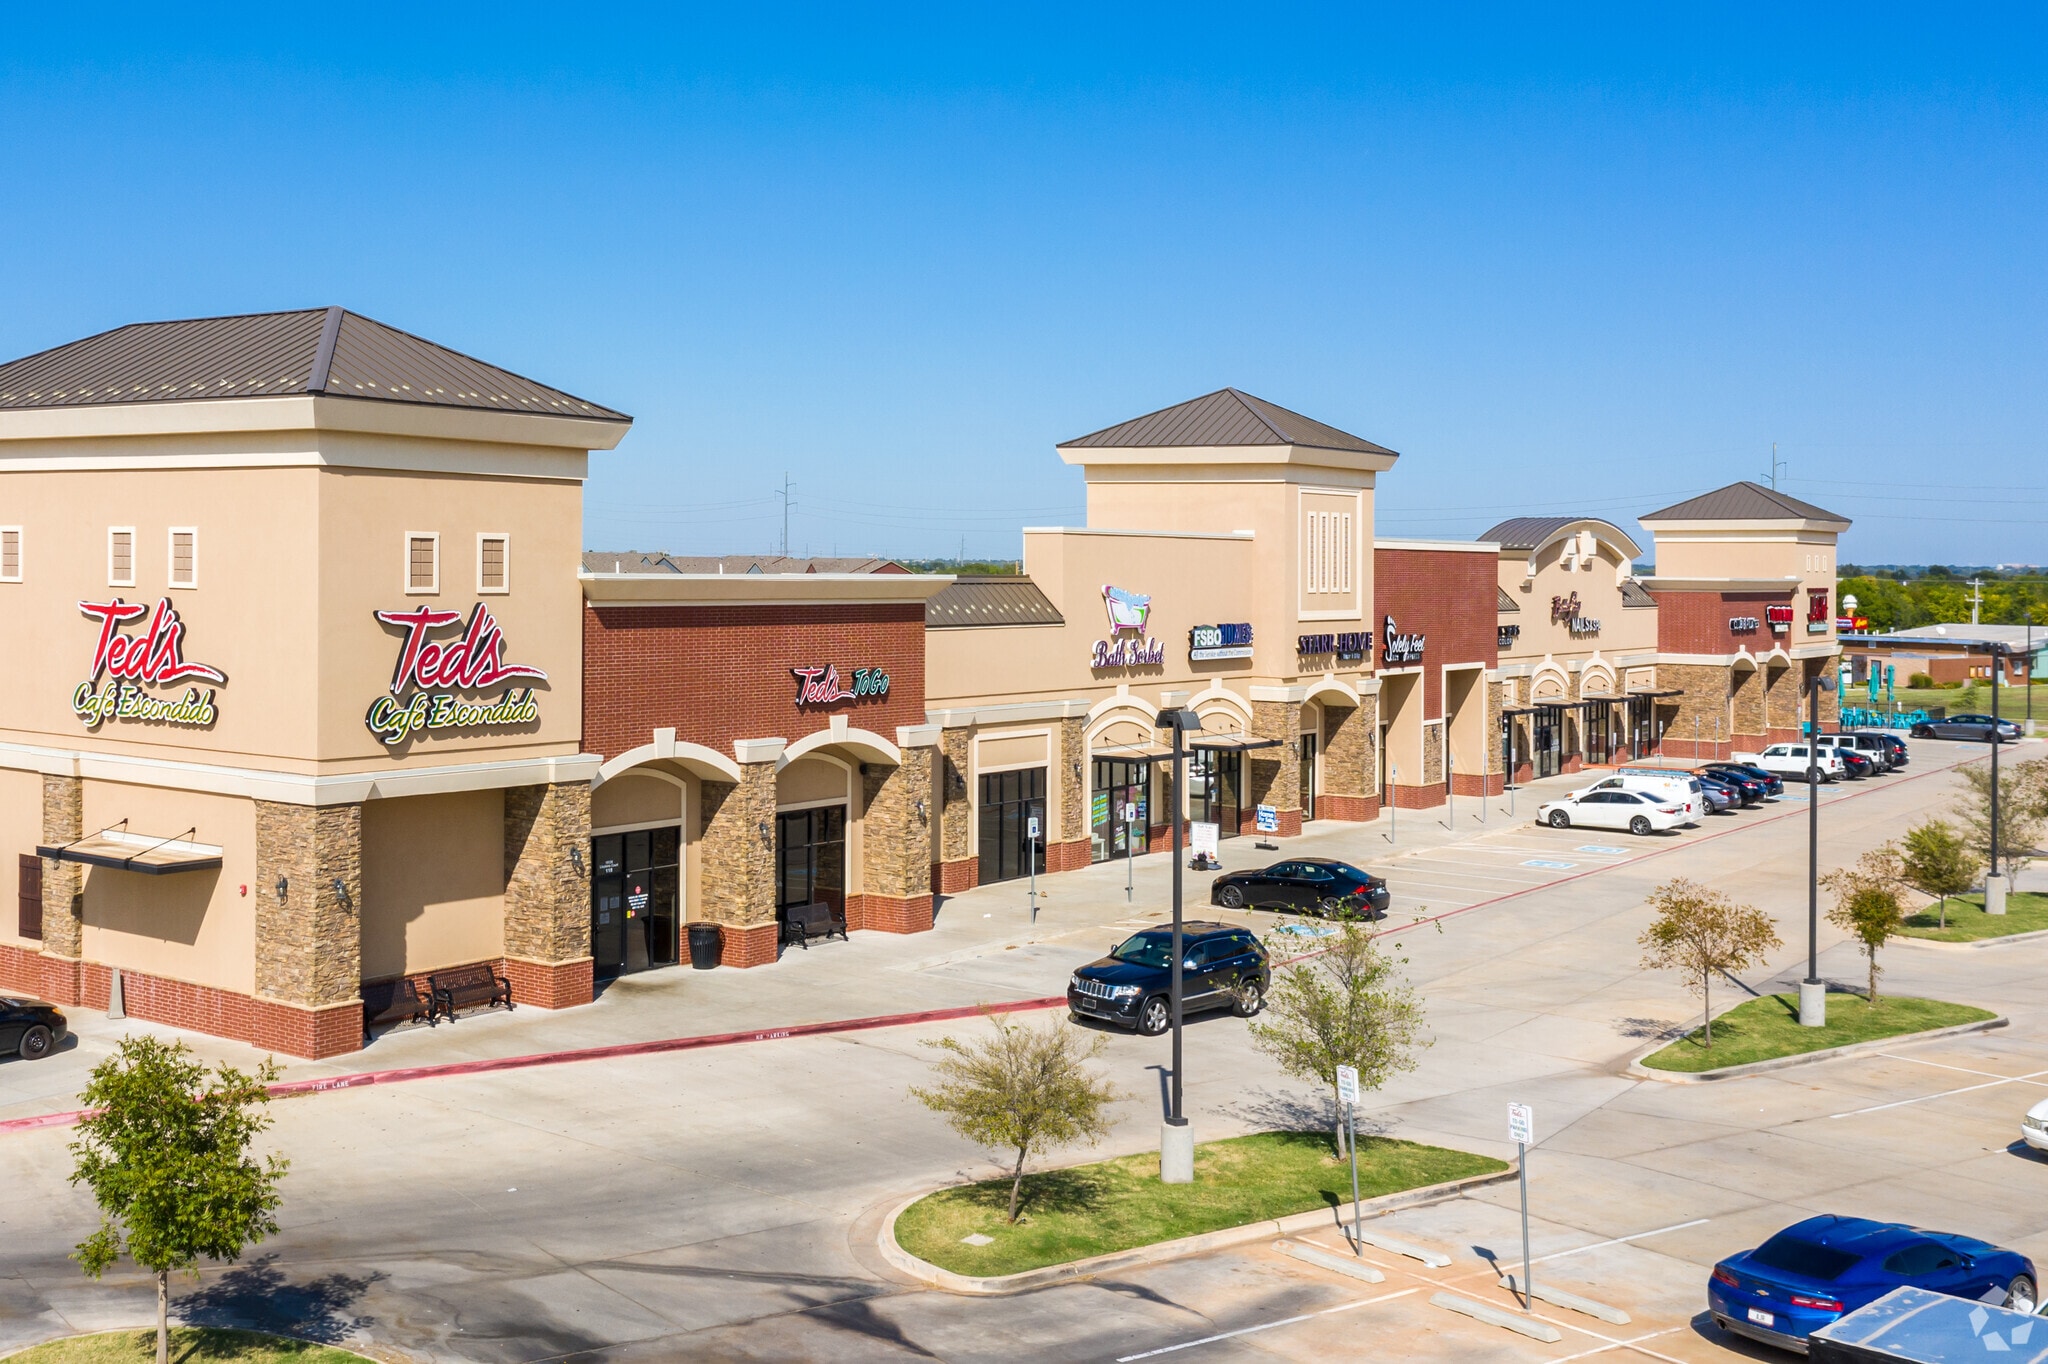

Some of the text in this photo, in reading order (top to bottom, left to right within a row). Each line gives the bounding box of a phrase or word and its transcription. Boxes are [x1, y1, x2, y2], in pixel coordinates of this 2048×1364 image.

[78, 597, 224, 683] Ted's
[377, 602, 548, 694] Ted's
[1092, 637, 1164, 668] Bath Sorbet
[1194, 628, 1222, 647] FSBO
[1300, 632, 1373, 654] STARR HOME
[1411, 634, 1426, 653] Feet
[794, 664, 856, 705] Ted's
[72, 681, 214, 727] Café Escondido
[370, 688, 537, 744] Café Escondido
[312, 1080, 350, 1091] FIRE LANE
